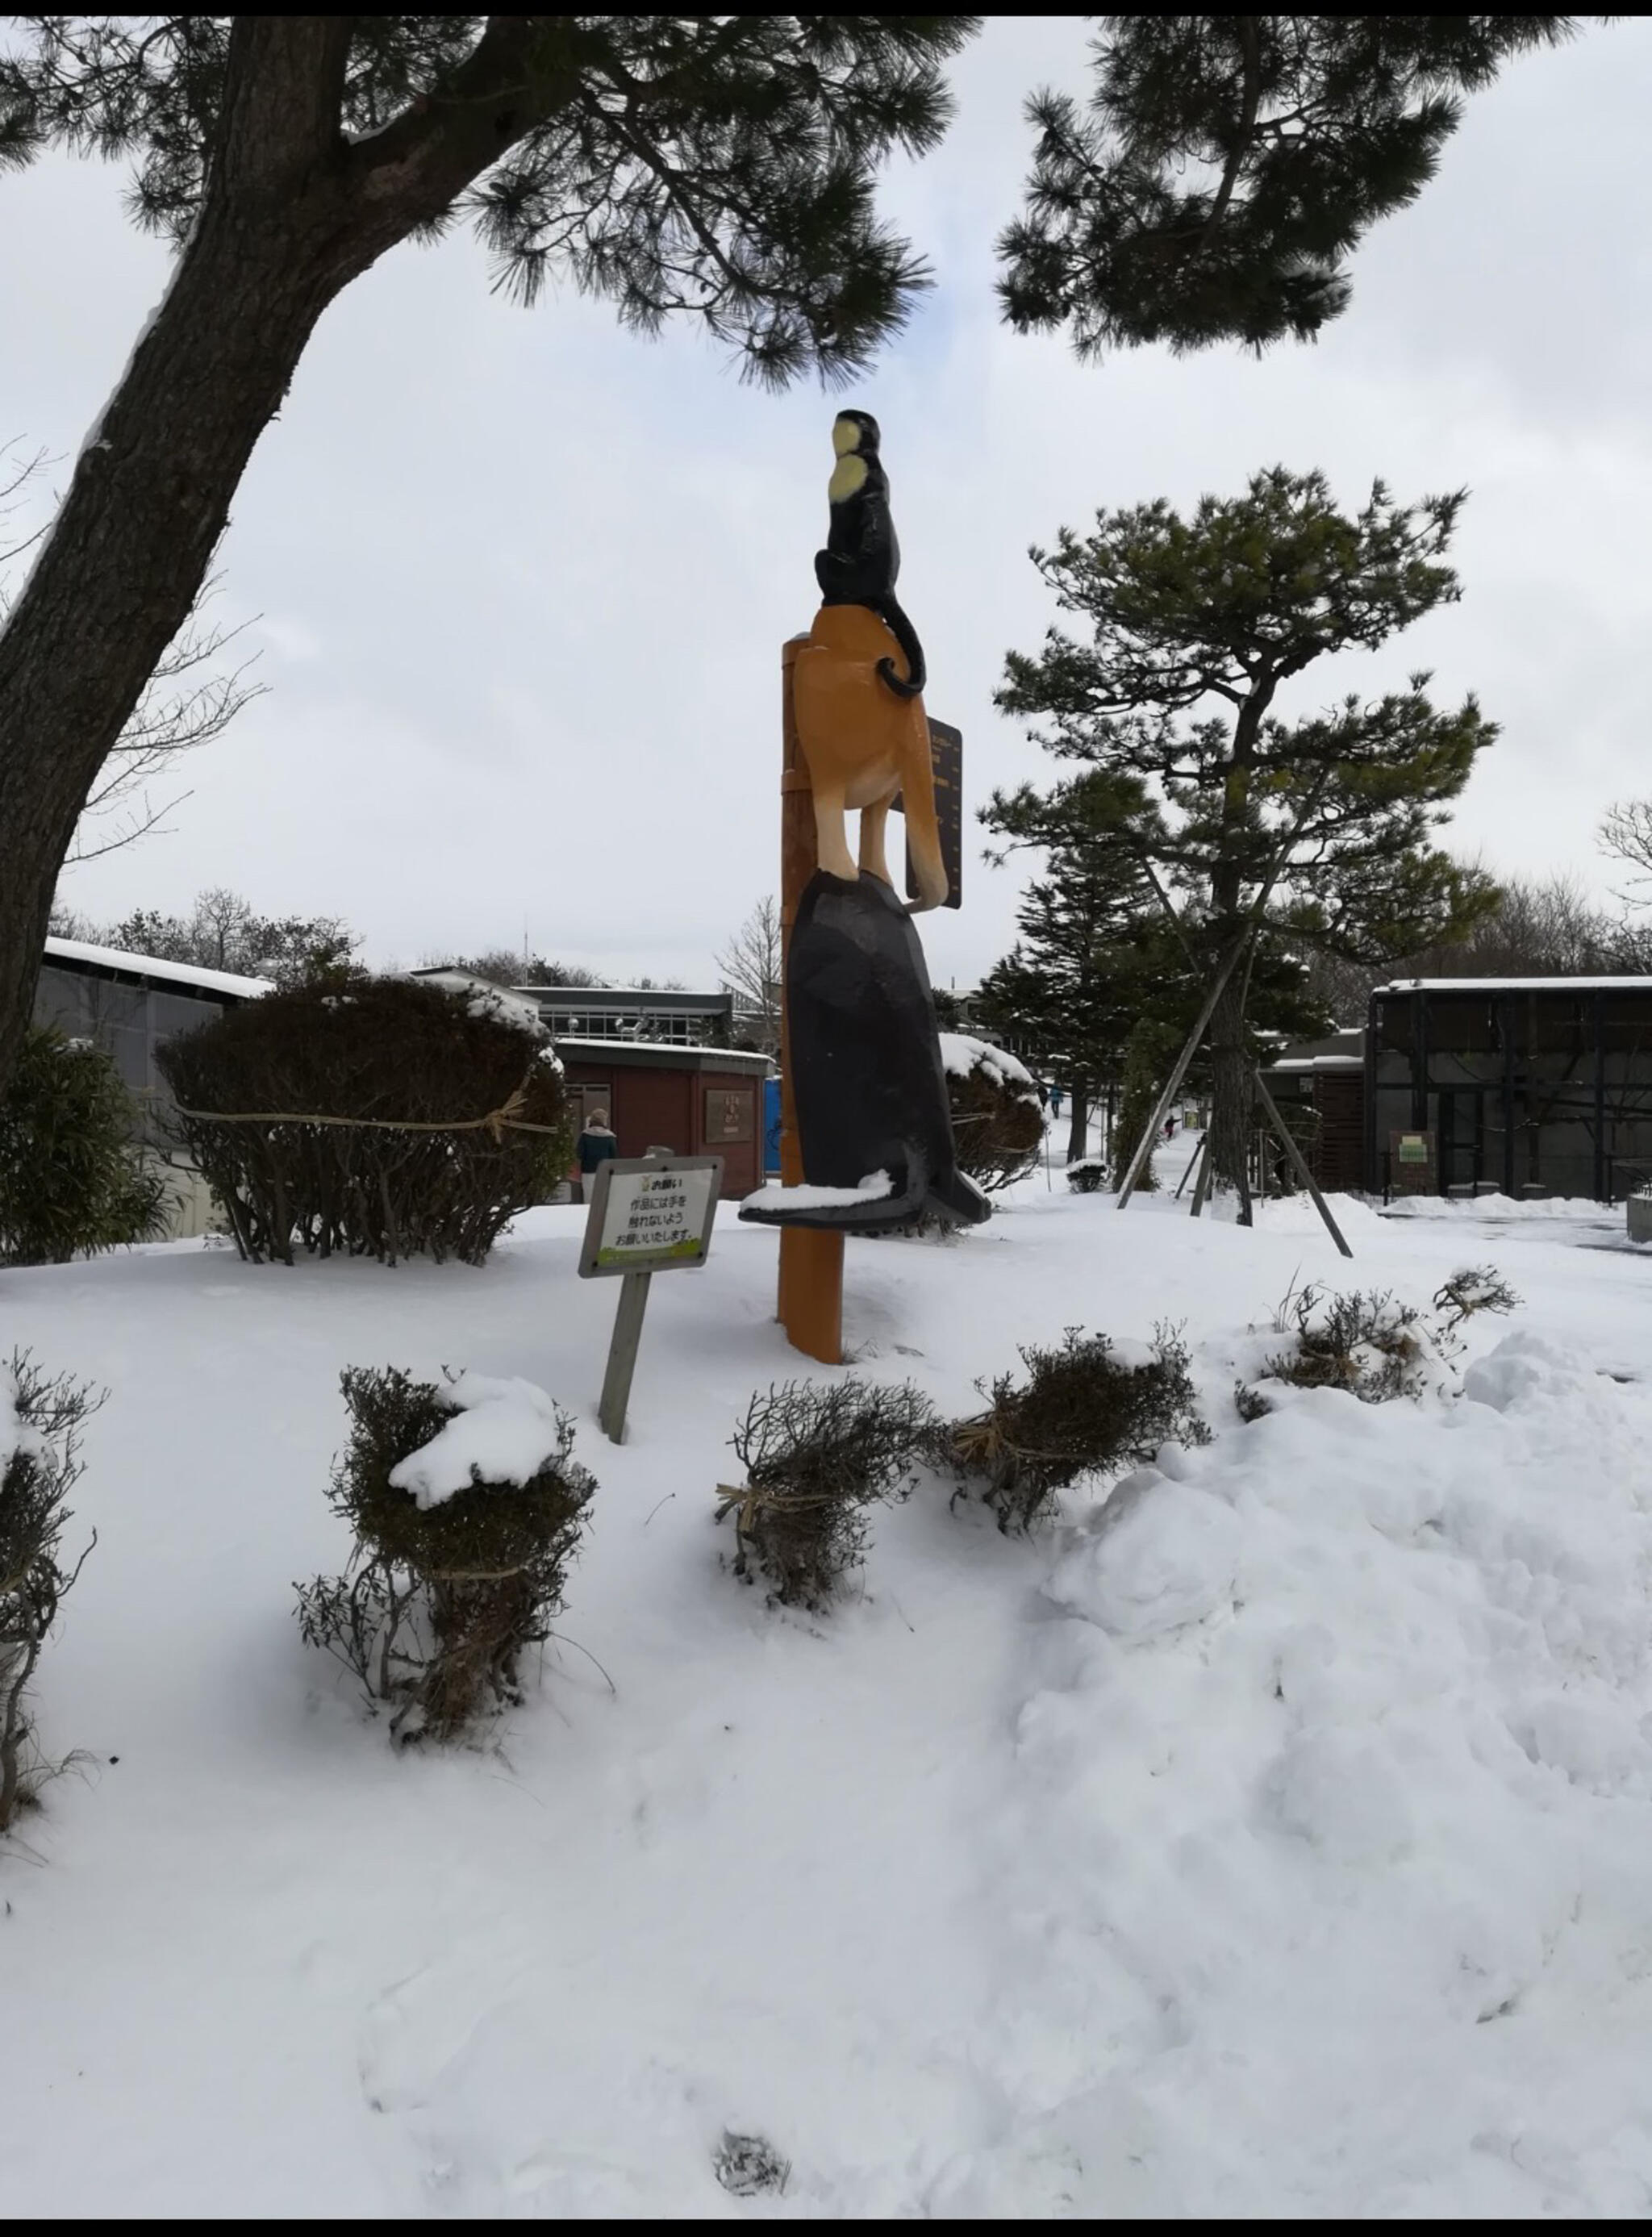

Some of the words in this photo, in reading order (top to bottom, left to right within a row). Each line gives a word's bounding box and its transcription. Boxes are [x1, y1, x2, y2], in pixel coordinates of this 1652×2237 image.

[630, 1196, 686, 1211] 作品には手を
